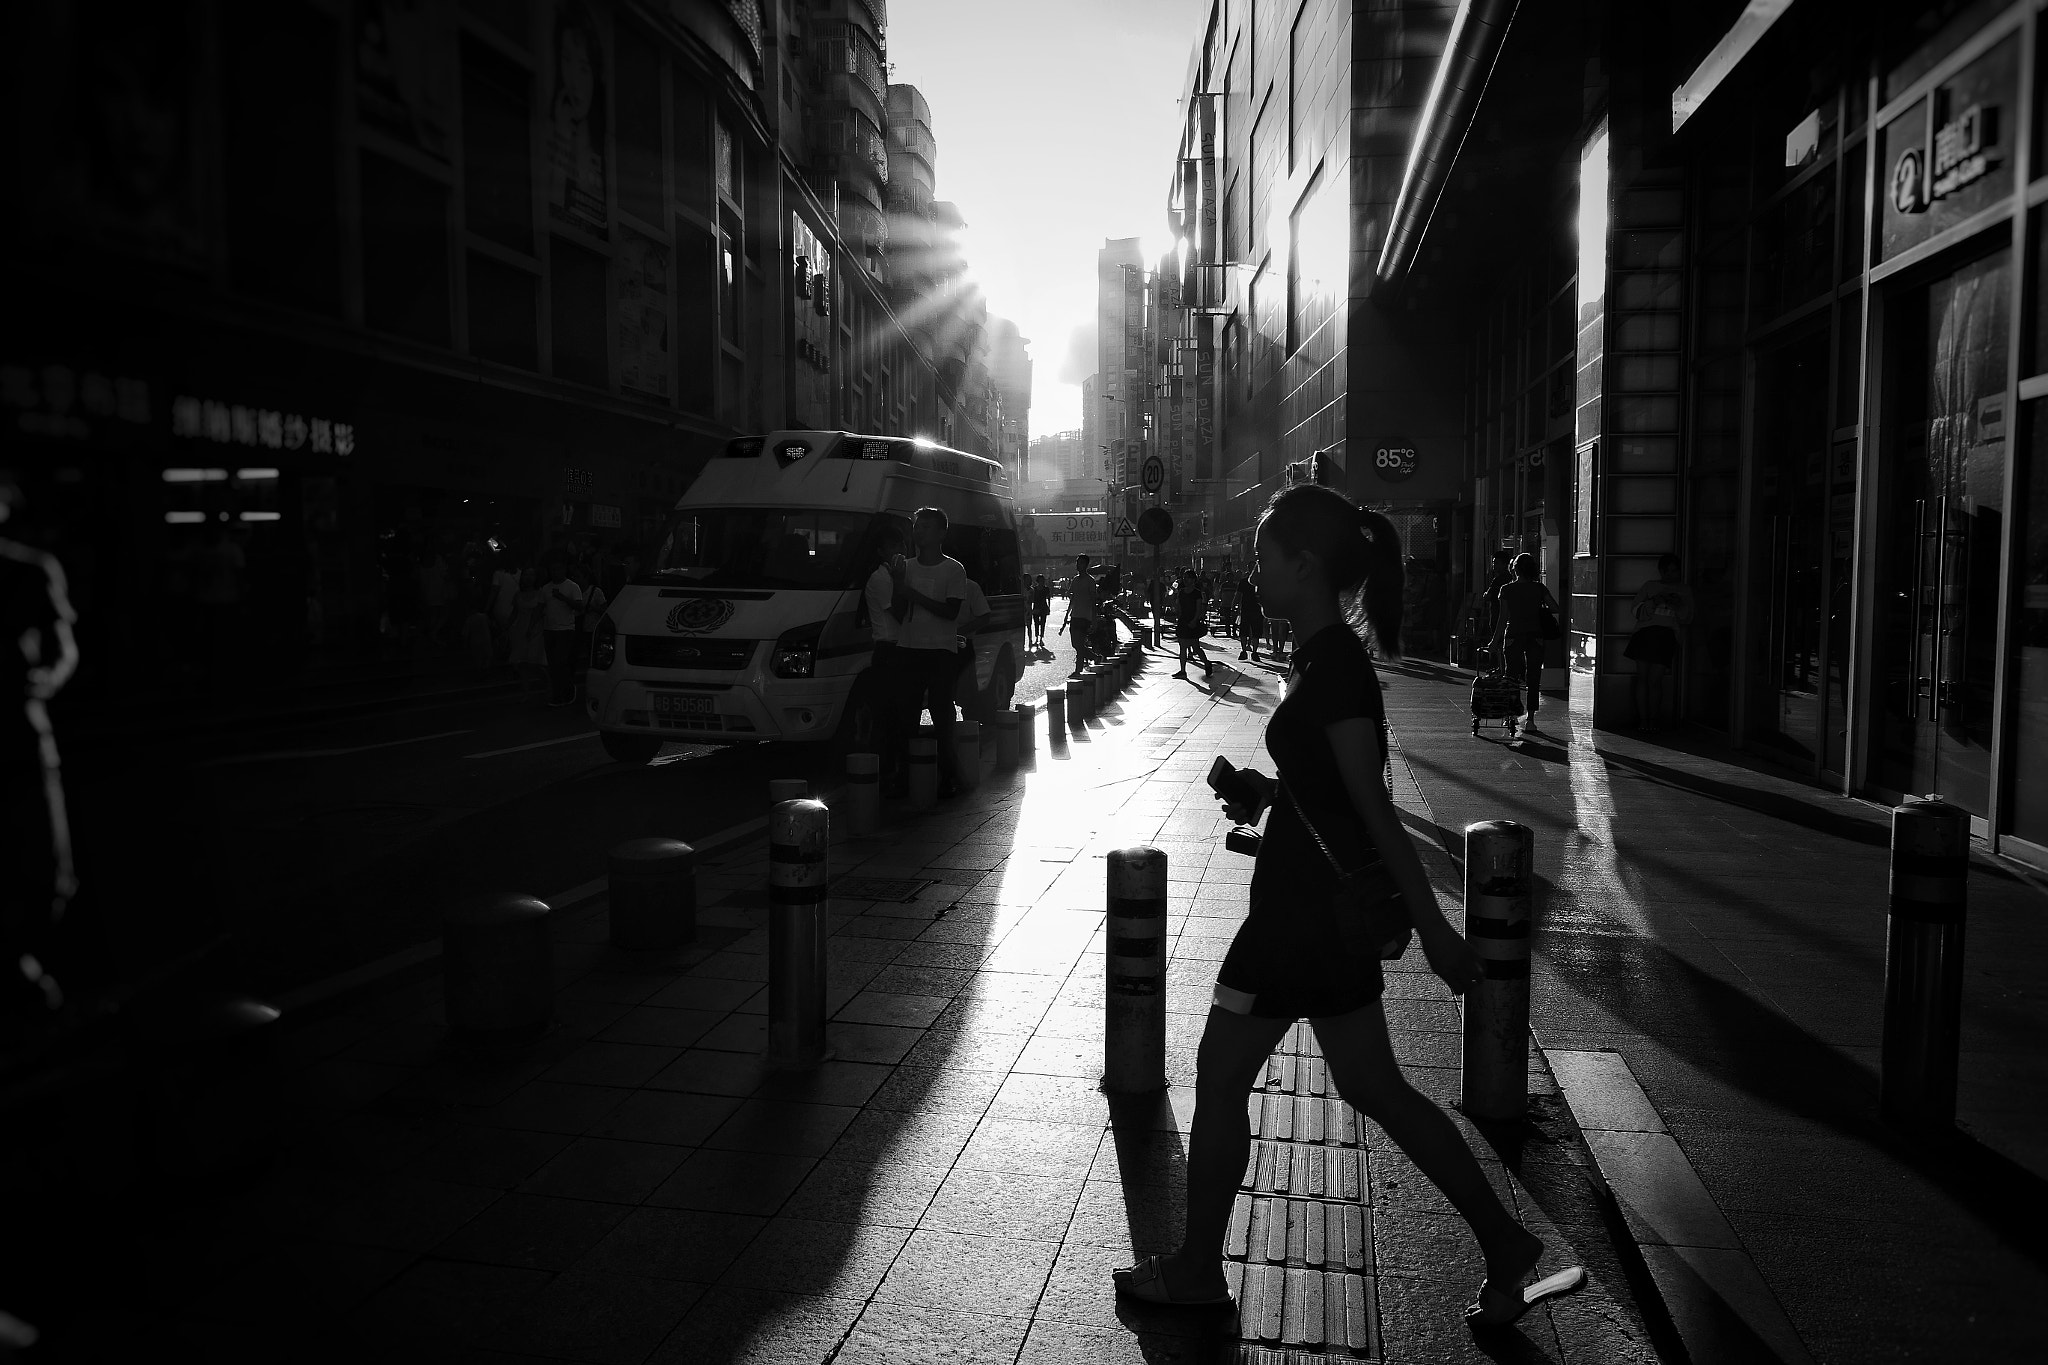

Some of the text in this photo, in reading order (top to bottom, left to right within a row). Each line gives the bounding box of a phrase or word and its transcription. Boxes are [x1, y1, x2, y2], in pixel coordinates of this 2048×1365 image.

[1202, 133, 1217, 227] SUN PLAZA
[1198, 352, 1214, 446] SUN PLAZA
[1147, 465, 1158, 484] 20
[1171, 405, 1182, 477] SUN PLAZA
[1376, 448, 1415, 468] 85°C
